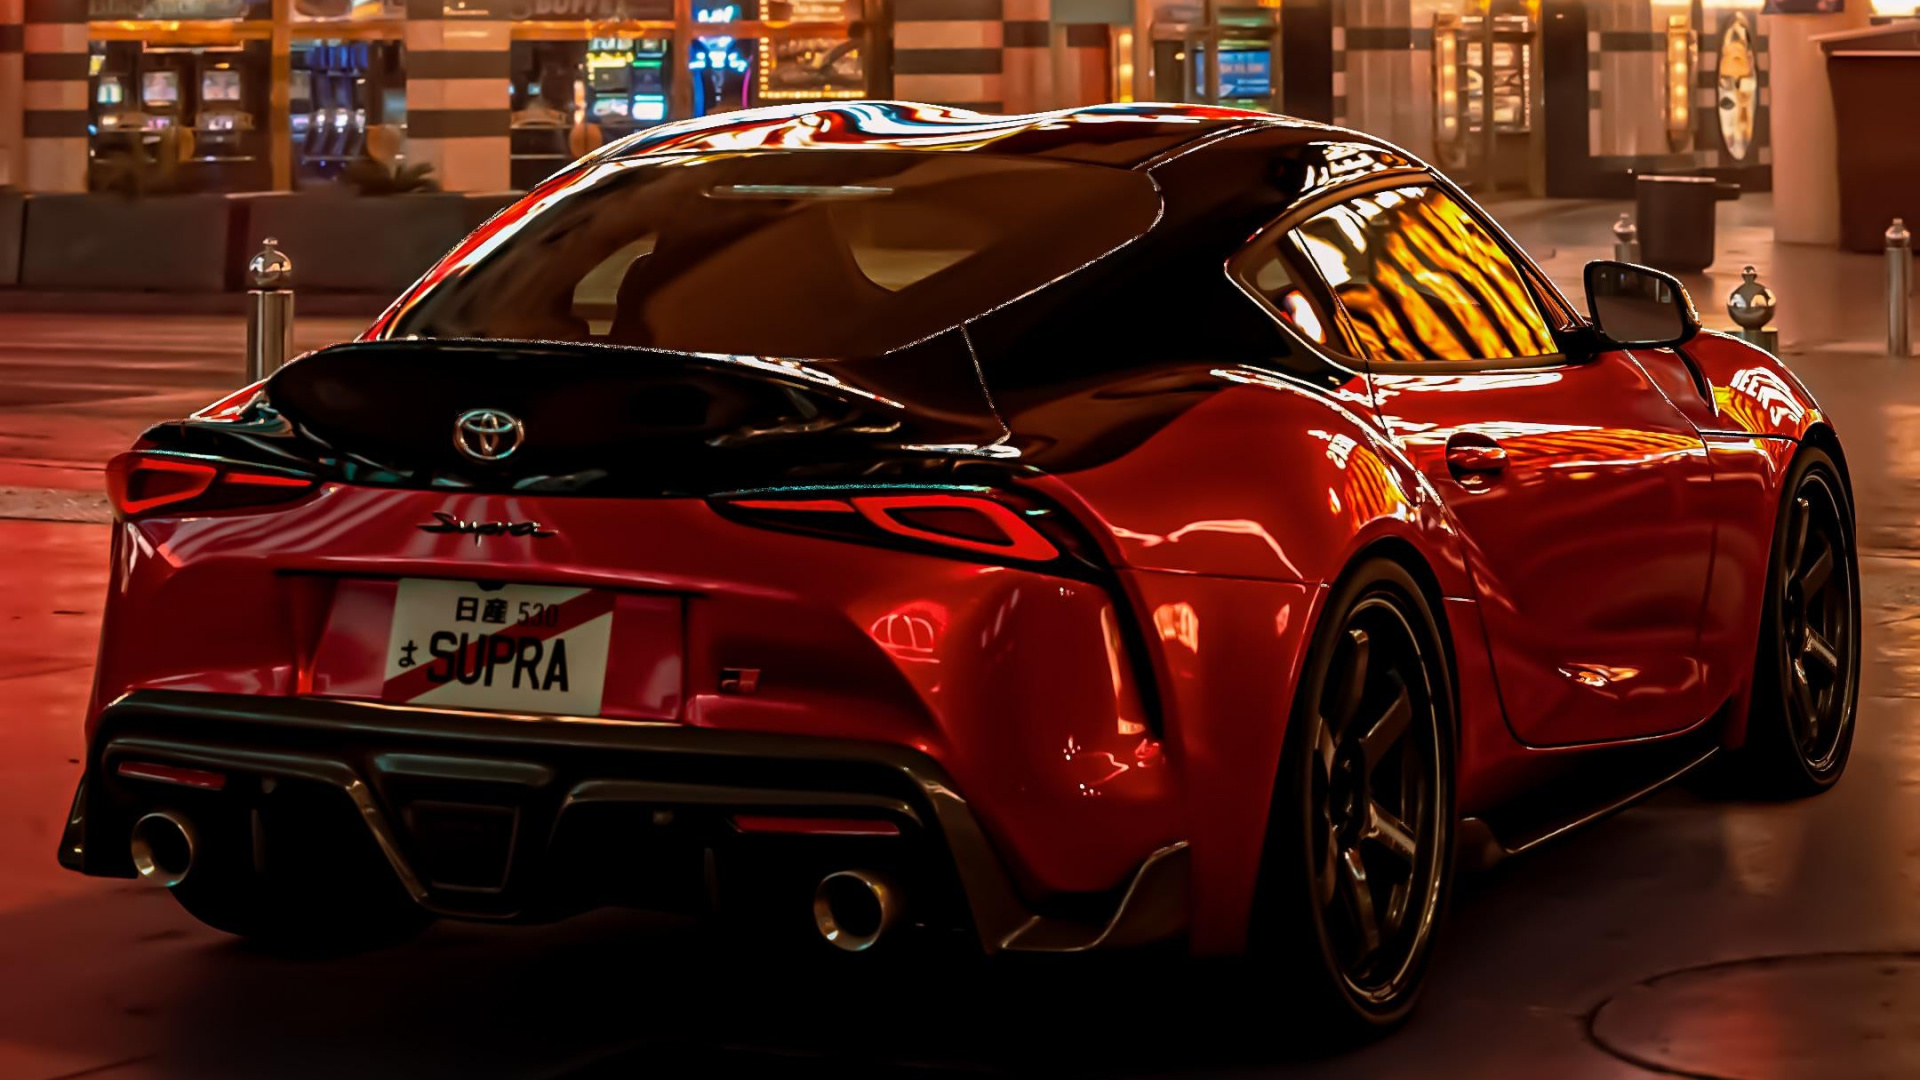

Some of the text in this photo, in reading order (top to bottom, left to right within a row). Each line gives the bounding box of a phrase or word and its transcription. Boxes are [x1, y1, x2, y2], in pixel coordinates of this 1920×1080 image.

[415, 510, 559, 547] Supra
[455, 596, 560, 628] 日産 530
[398, 631, 569, 692] よ SUPRA
